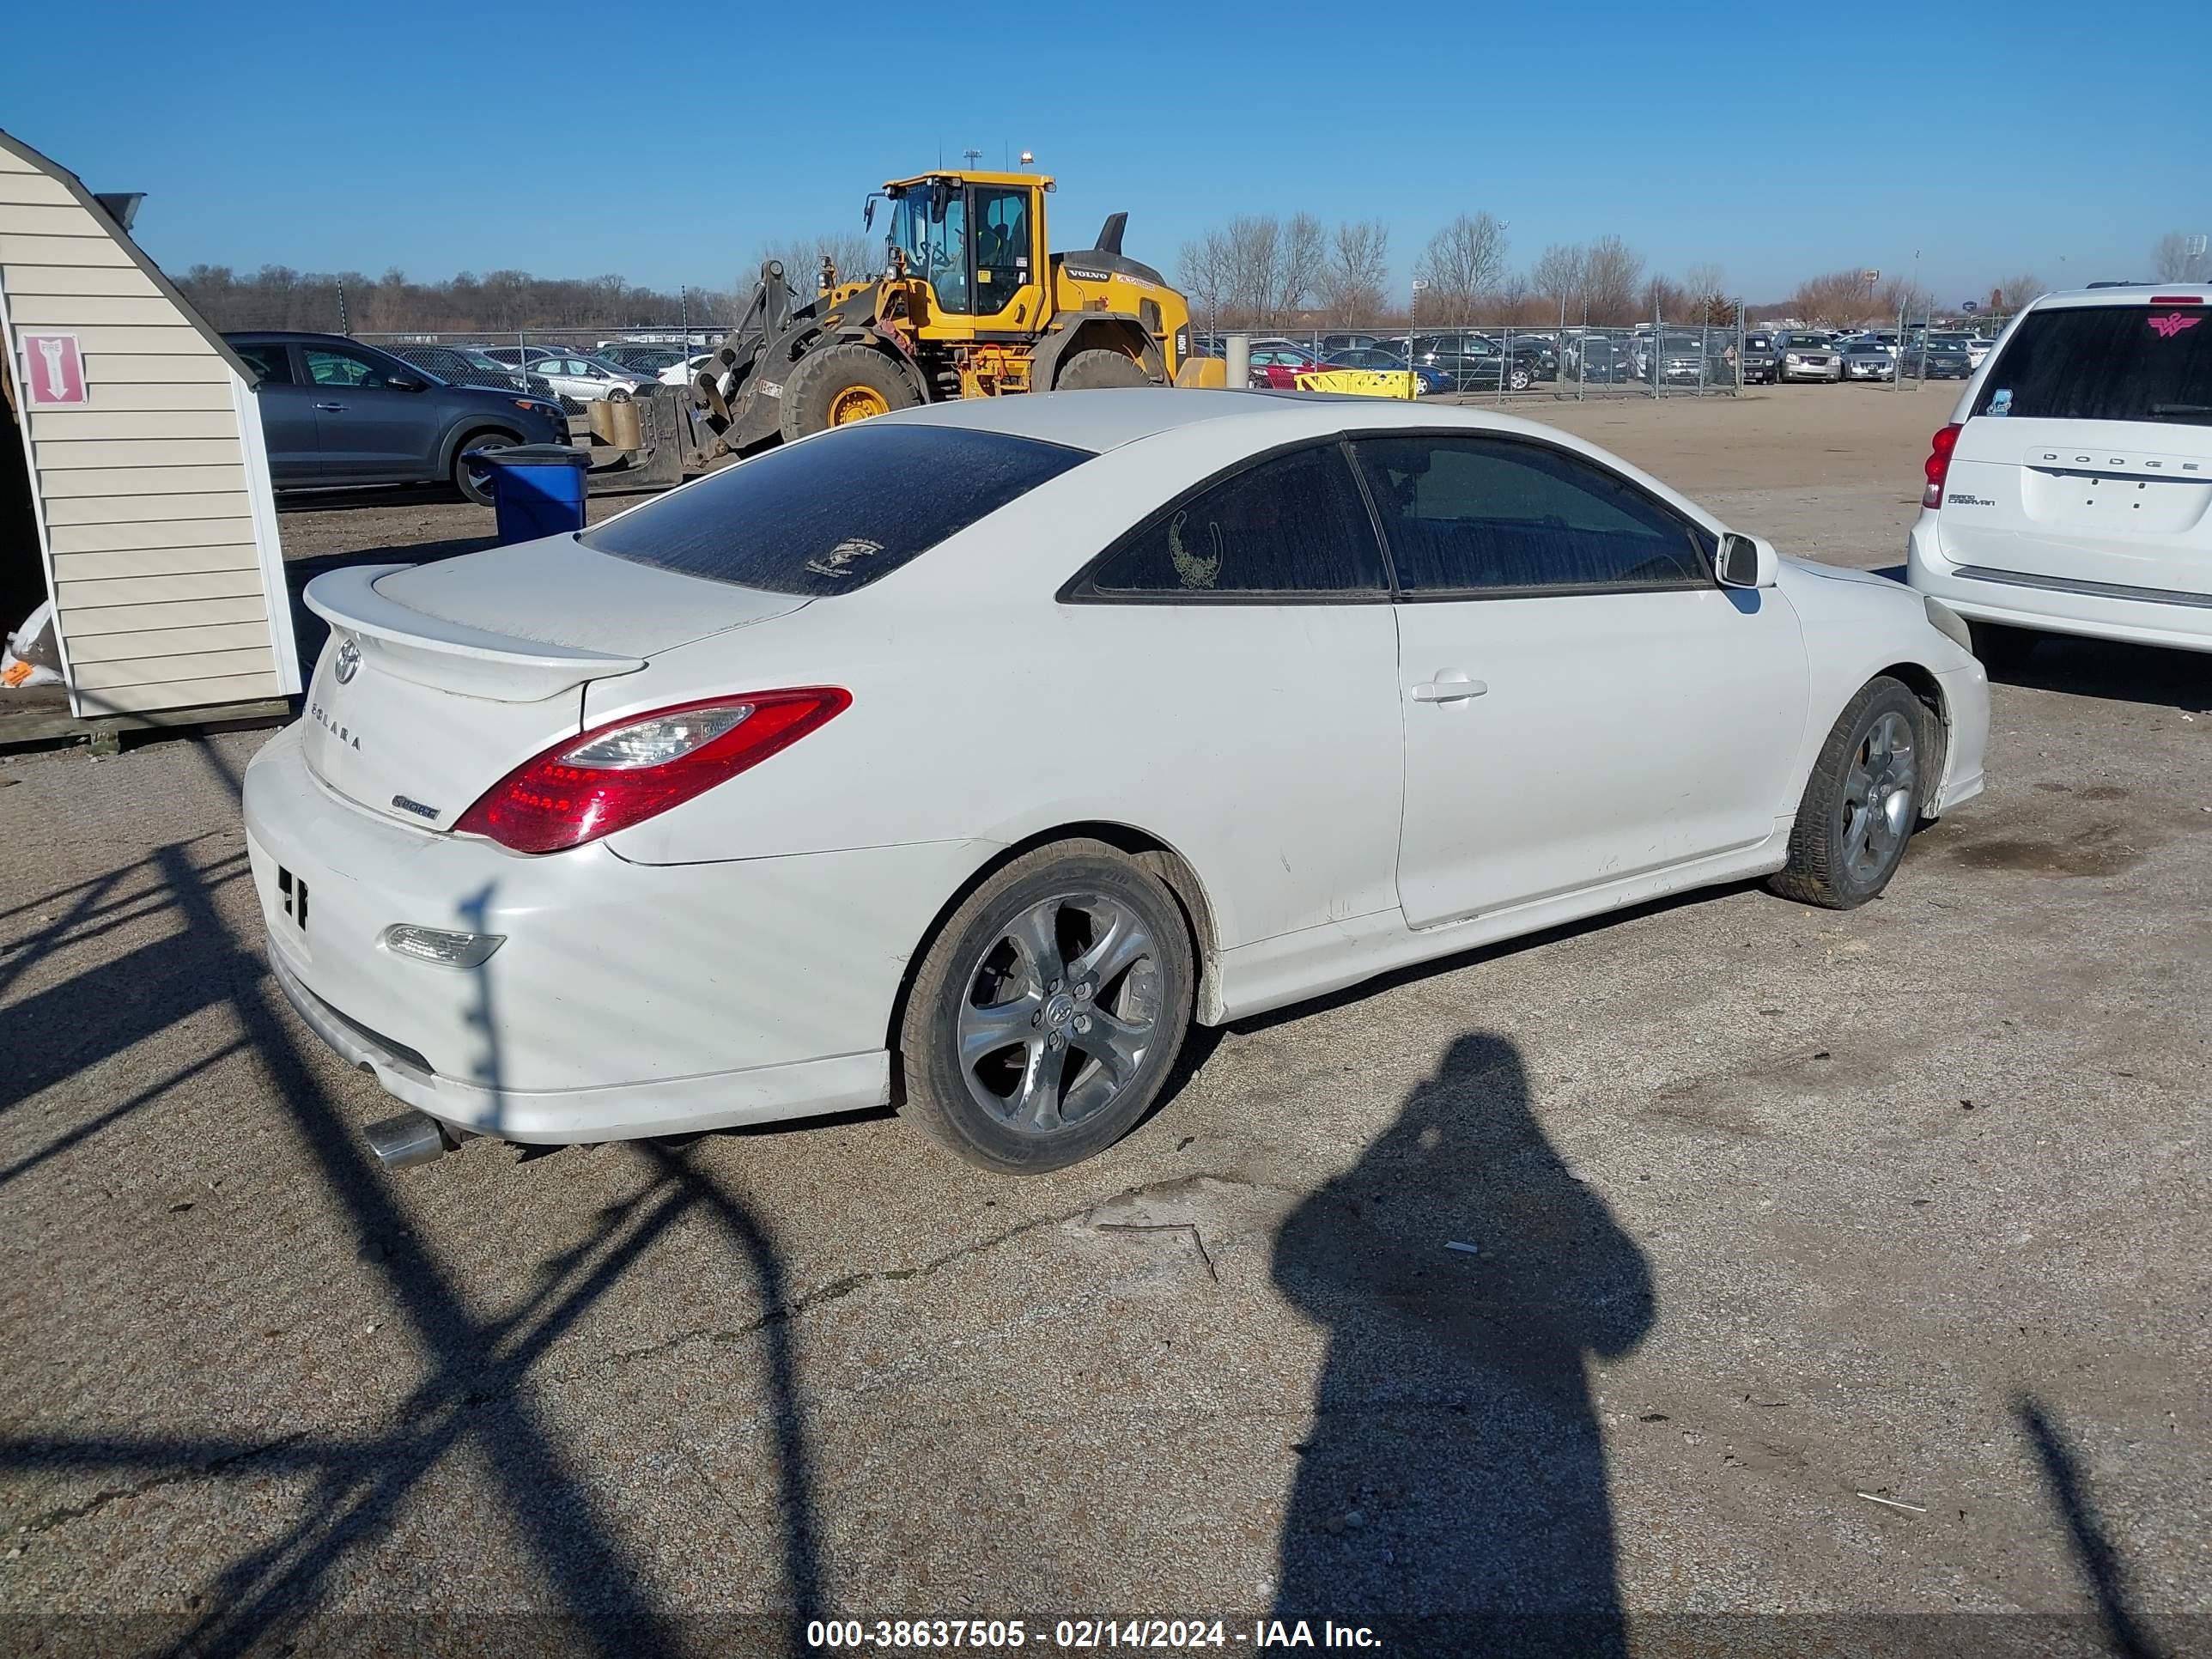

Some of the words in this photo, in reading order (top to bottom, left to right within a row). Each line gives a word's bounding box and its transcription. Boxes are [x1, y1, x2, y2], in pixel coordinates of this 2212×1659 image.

[1068, 270, 1108, 280] VOLVO
[40, 343, 61, 352] FIRE
[1177, 334, 1187, 355] L90H
[2043, 453, 2199, 471] DODGE
[311, 703, 361, 750] SOLARA
[392, 795, 440, 820] SPORT
